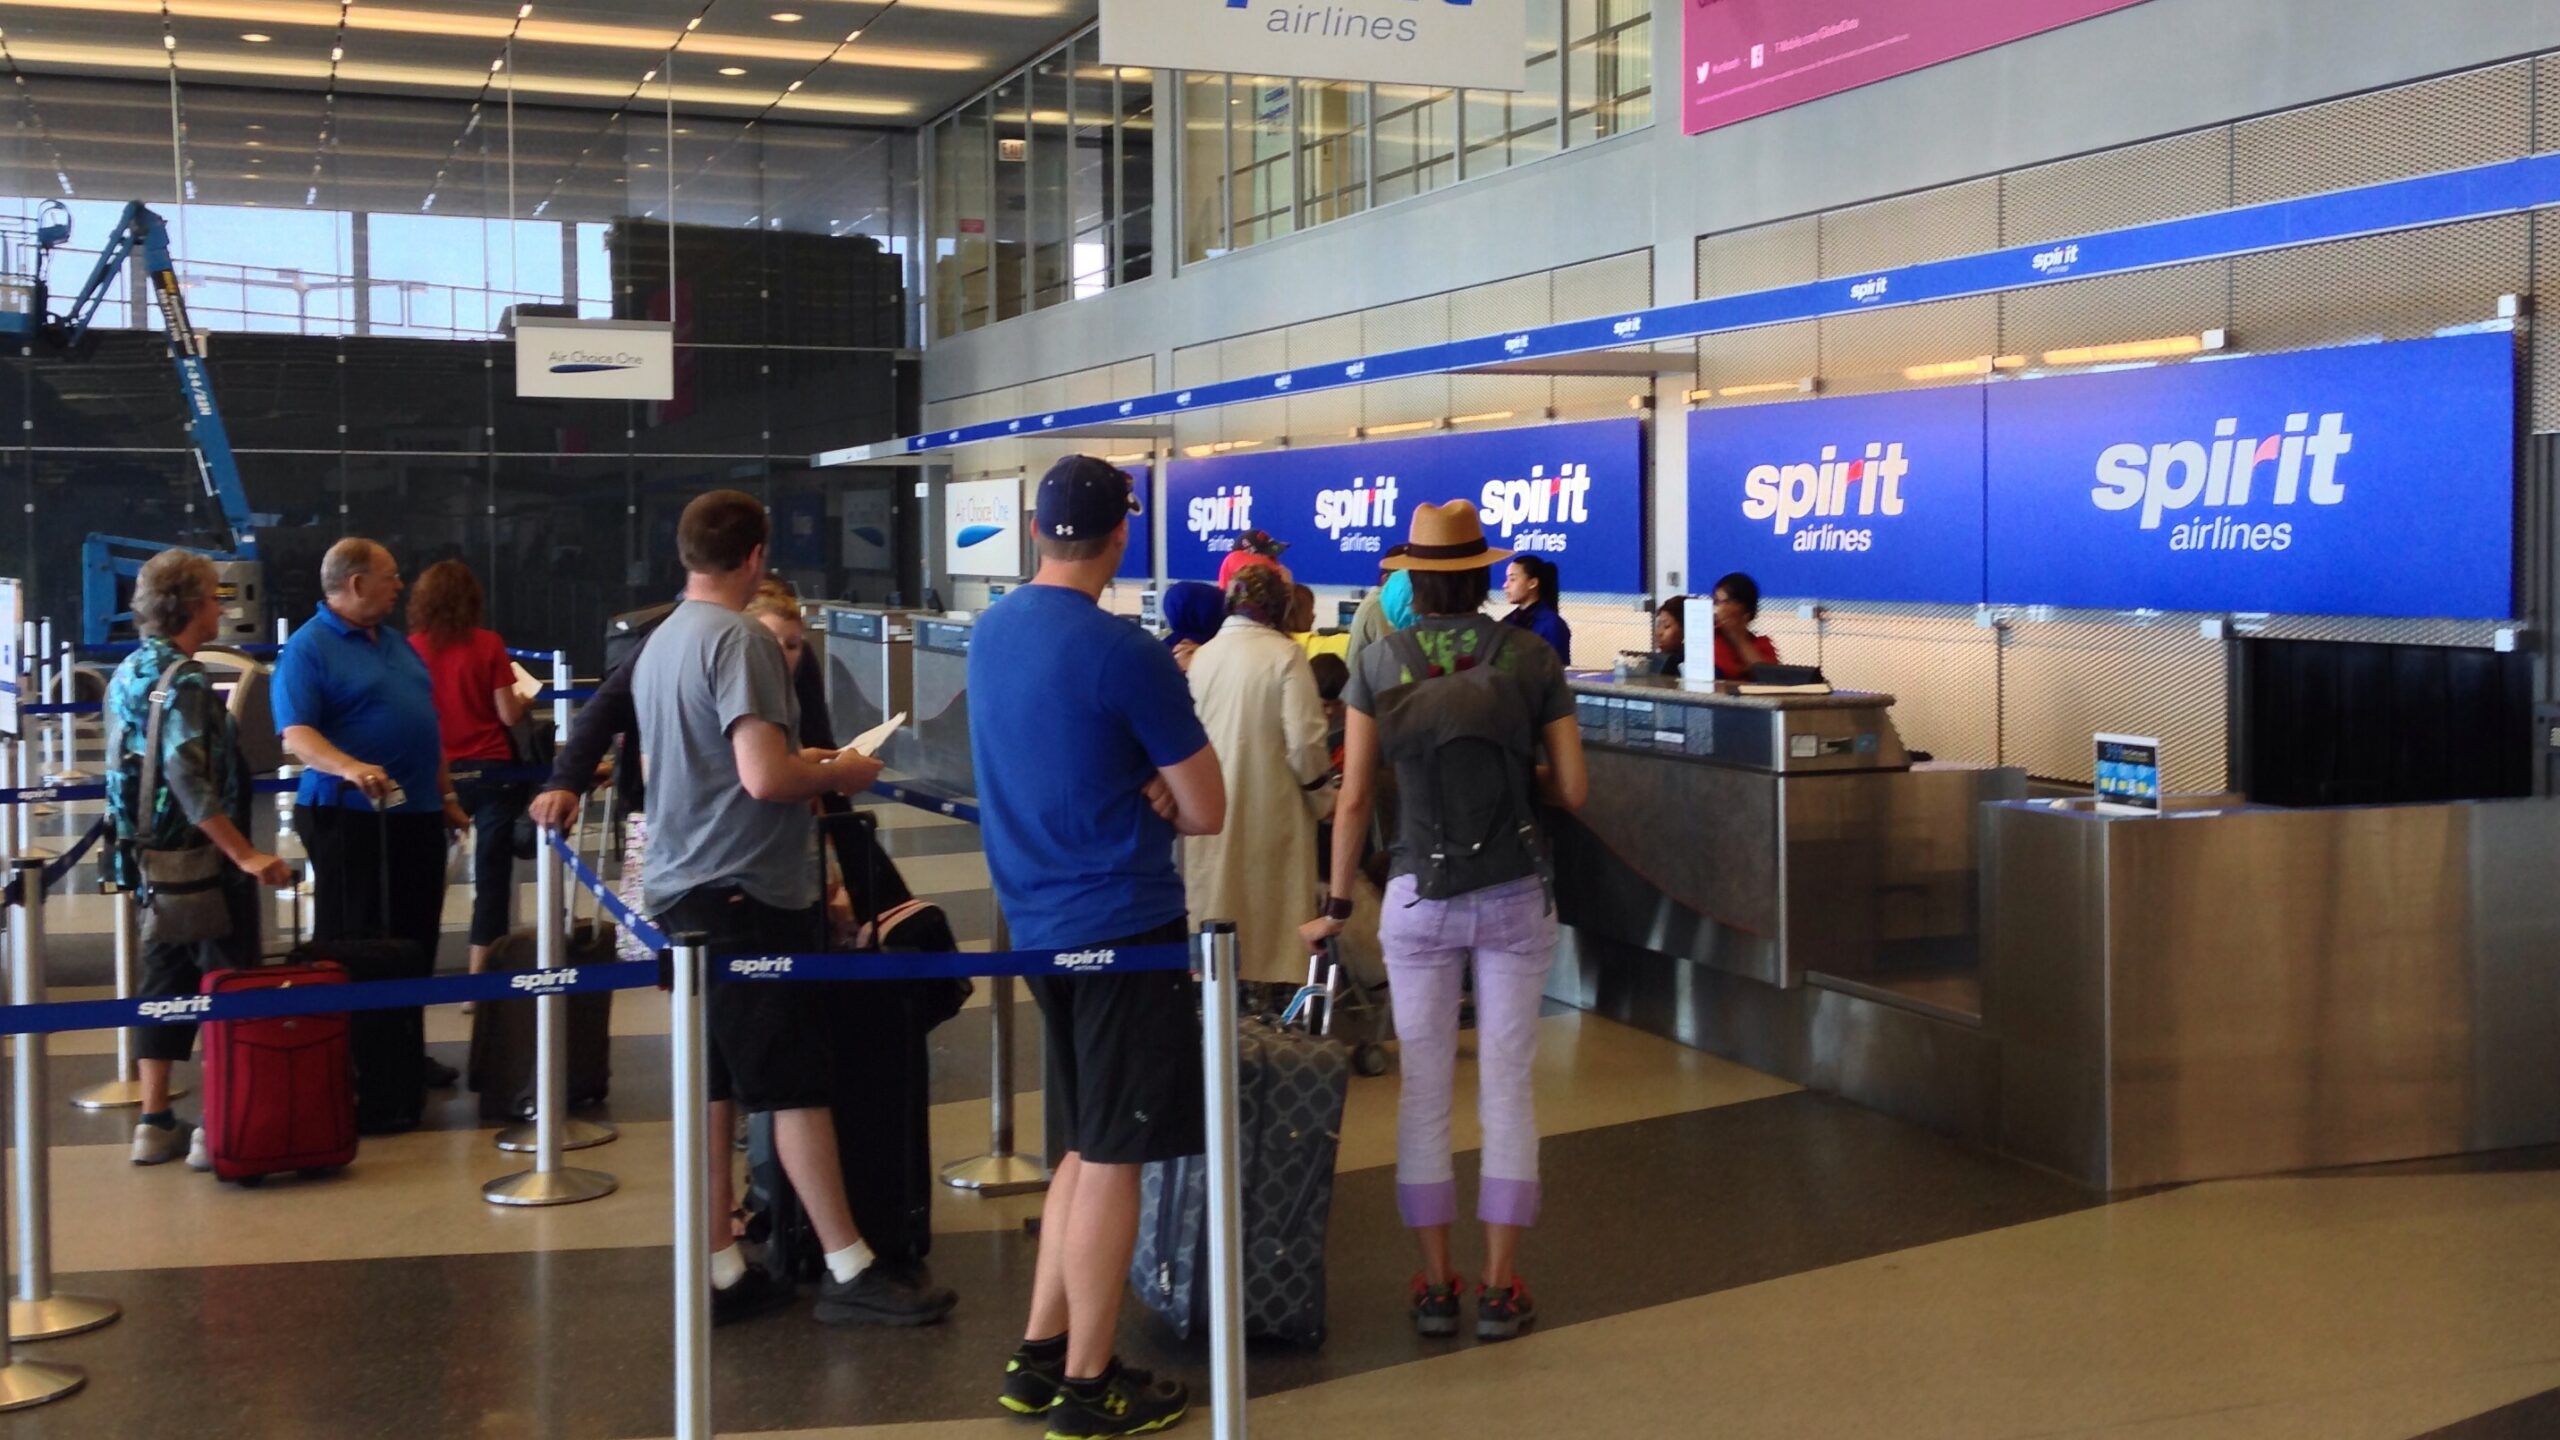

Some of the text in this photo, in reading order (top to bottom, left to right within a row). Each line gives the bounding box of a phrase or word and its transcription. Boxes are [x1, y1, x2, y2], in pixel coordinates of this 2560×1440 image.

[1266, 5, 1418, 42] airlines
[2032, 244, 2079, 272] spirit
[1850, 276, 1888, 300] spirit
[570, 350, 613, 363] Choice
[616, 352, 643, 365] One
[2090, 411, 2353, 530] spirit
[1480, 463, 1591, 538] spirit
[1742, 442, 1909, 534] spirit
[1187, 485, 1252, 542] spirit
[1314, 475, 1399, 538] spirit
[1207, 534, 1234, 552] airline
[1340, 532, 1381, 553] airlines
[1513, 528, 1568, 553] airlines
[1792, 522, 1872, 552] airlines
[2168, 515, 2293, 552] airlines
[729, 956, 793, 975] spirit
[1053, 949, 1116, 968] spirit
[510, 968, 579, 991] spirit
[137, 994, 213, 1018] spirit
